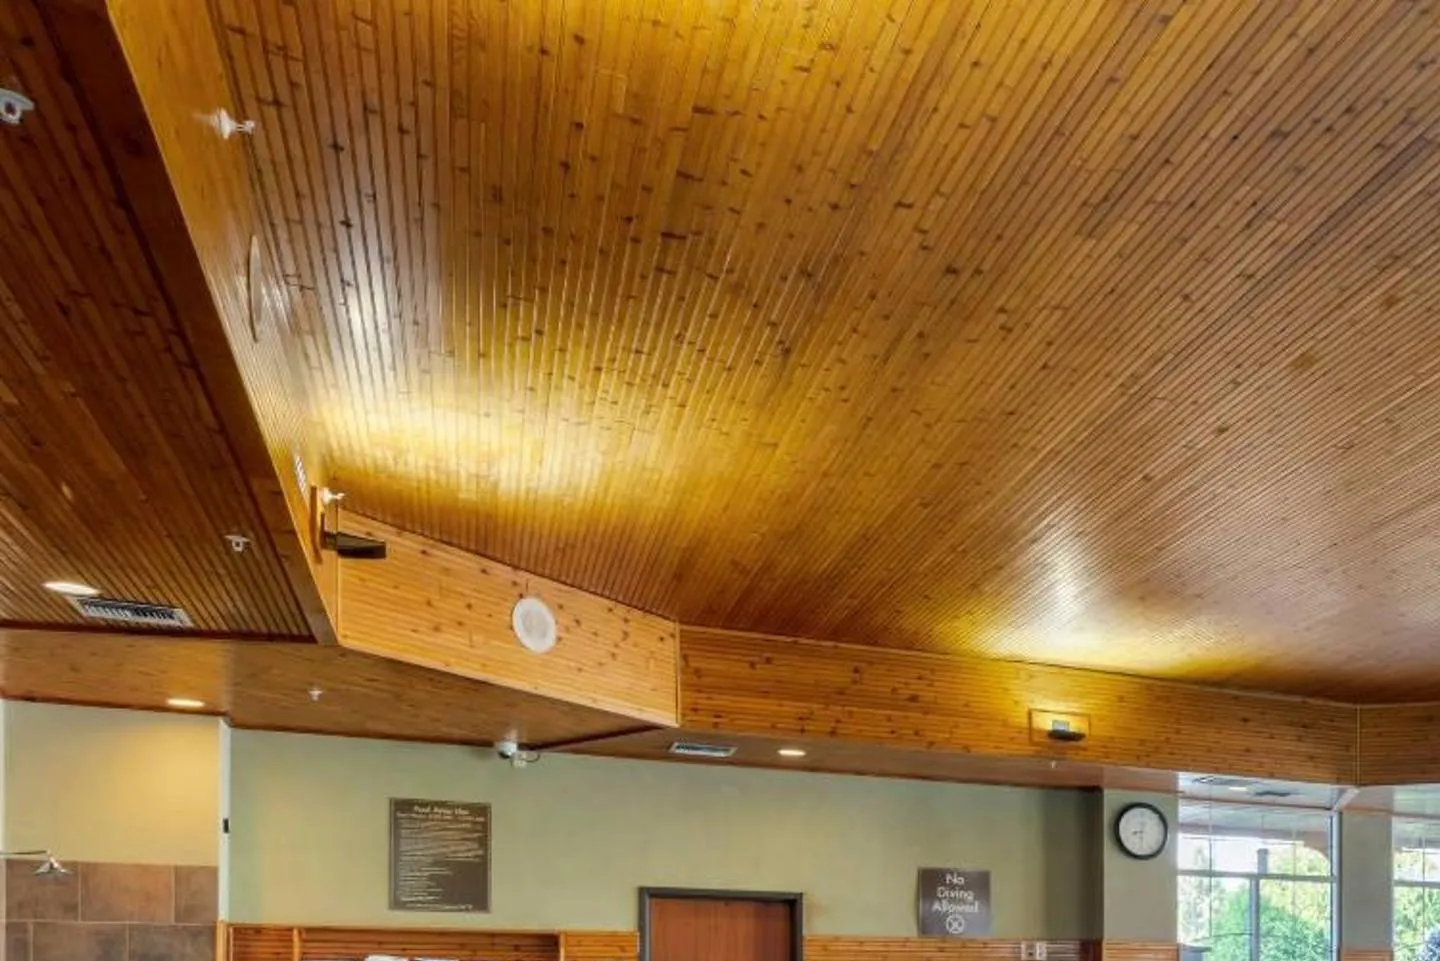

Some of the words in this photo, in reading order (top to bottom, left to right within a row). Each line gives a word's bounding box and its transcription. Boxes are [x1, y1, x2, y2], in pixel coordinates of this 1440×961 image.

[945, 872, 965, 885] No
[936, 886, 974, 902] Diving
[931, 900, 979, 914] Allowed
